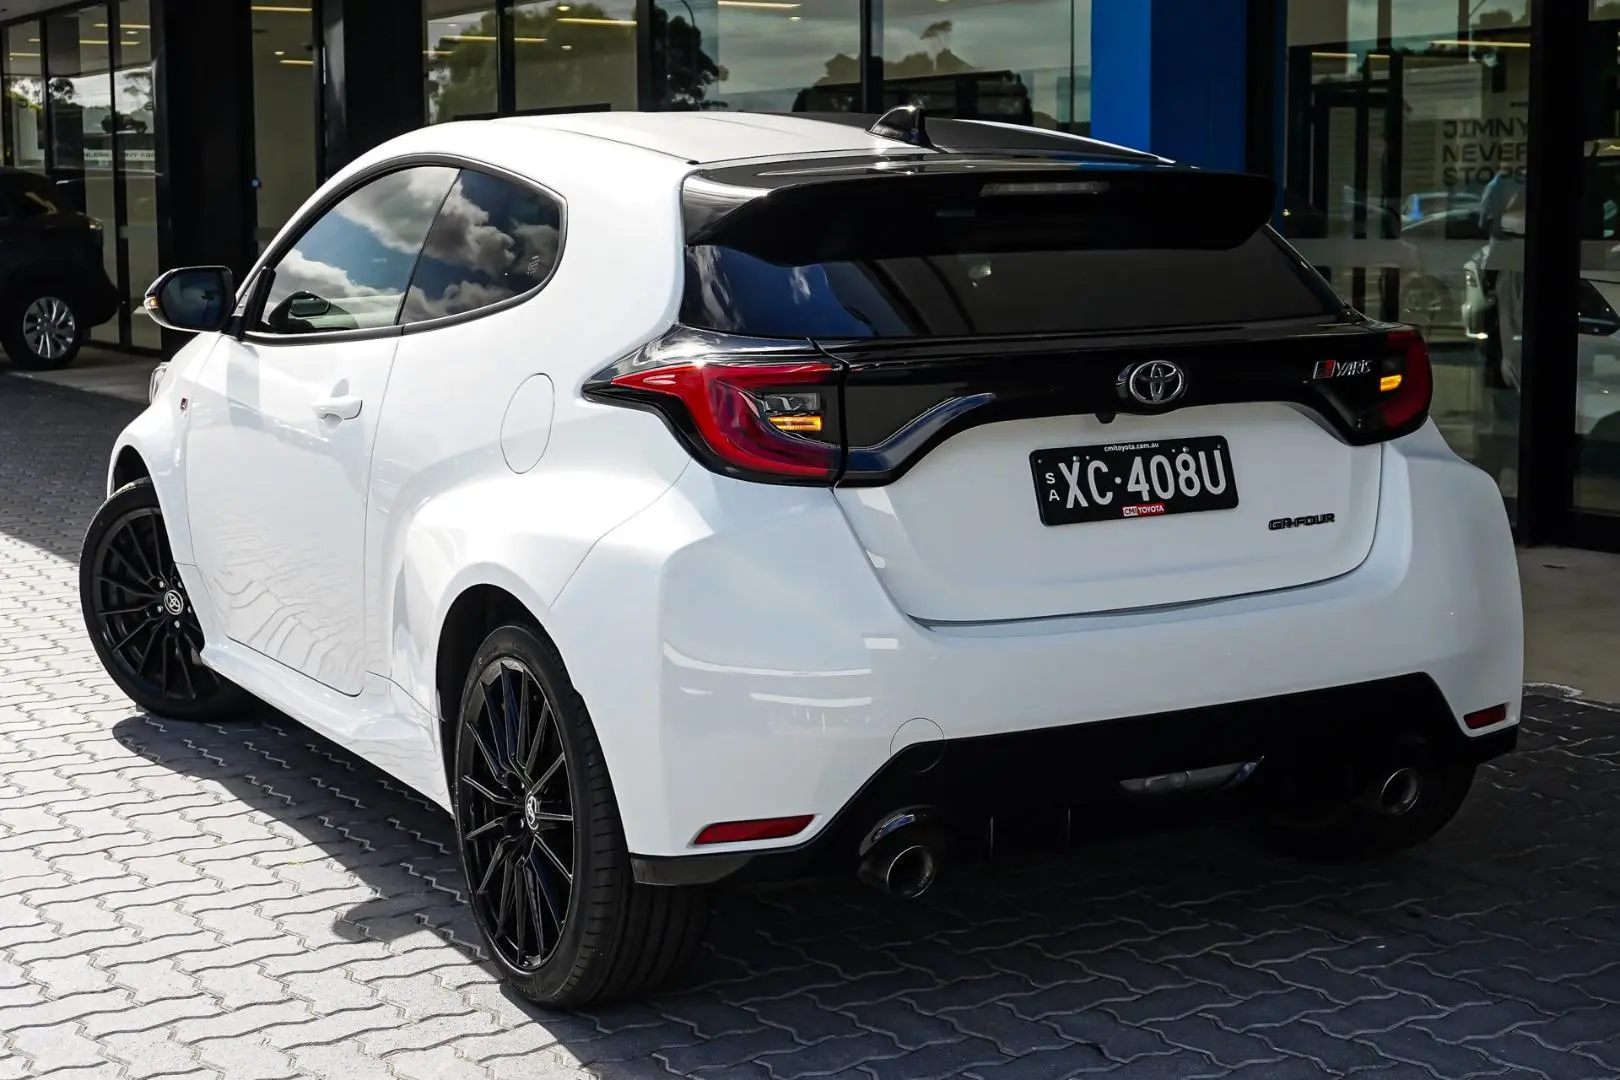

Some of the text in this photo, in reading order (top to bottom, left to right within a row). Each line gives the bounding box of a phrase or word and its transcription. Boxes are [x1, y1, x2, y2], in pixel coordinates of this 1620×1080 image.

[1443, 118, 1529, 139] JIMNY
[1104, 442, 1160, 453] cmitoyota.com.au
[1138, 505, 1165, 514] TOYOTA
